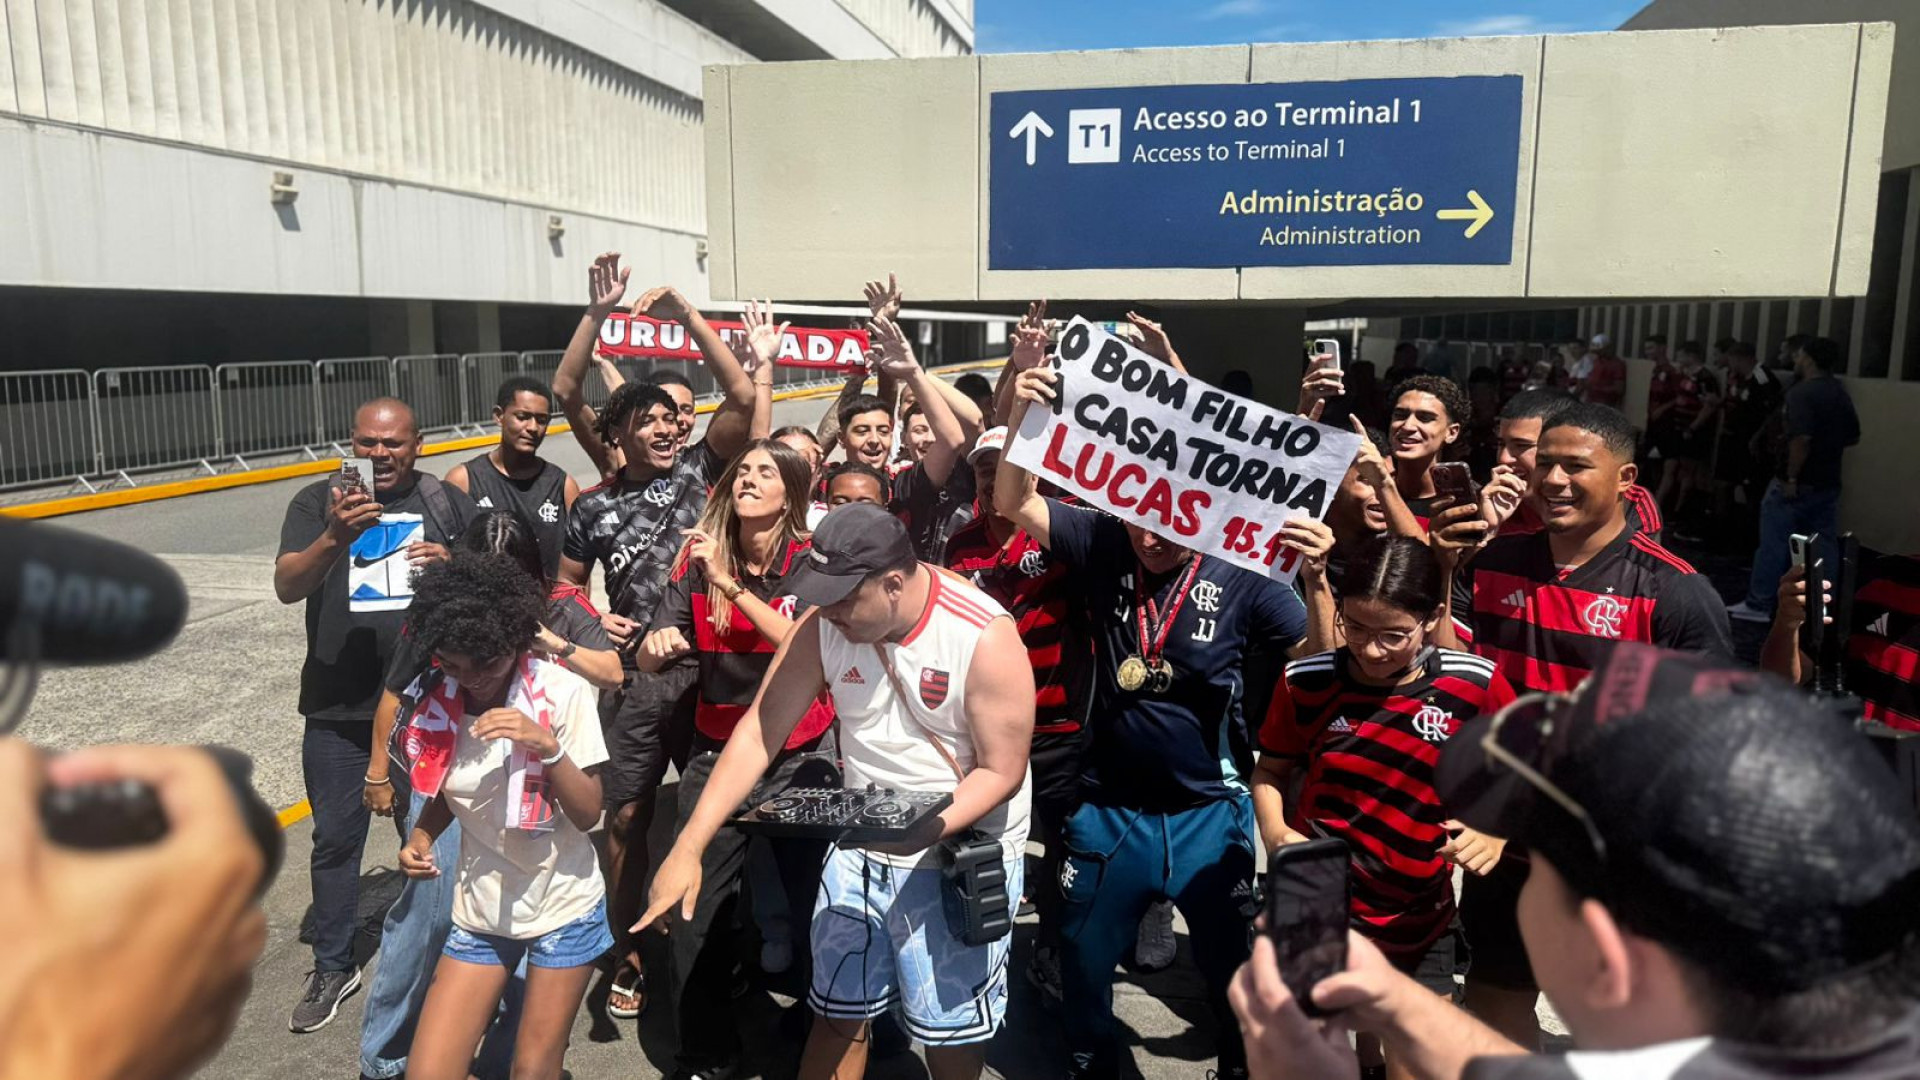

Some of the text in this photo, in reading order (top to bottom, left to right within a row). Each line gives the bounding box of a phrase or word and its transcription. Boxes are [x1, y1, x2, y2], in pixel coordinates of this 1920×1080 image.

[1133, 97, 1421, 131] Acesso ao Terminal 1
[1078, 124, 1112, 149] T1
[1132, 137, 1345, 163] Access to Terminal 1
[1219, 186, 1424, 218] Administração
[1259, 225, 1421, 246] Administration
[1060, 323, 1321, 457] O BOM FILHO
[1074, 393, 1179, 471] CASA
[1186, 437, 1327, 518] TORNA
[1042, 422, 1212, 536] LUCAS
